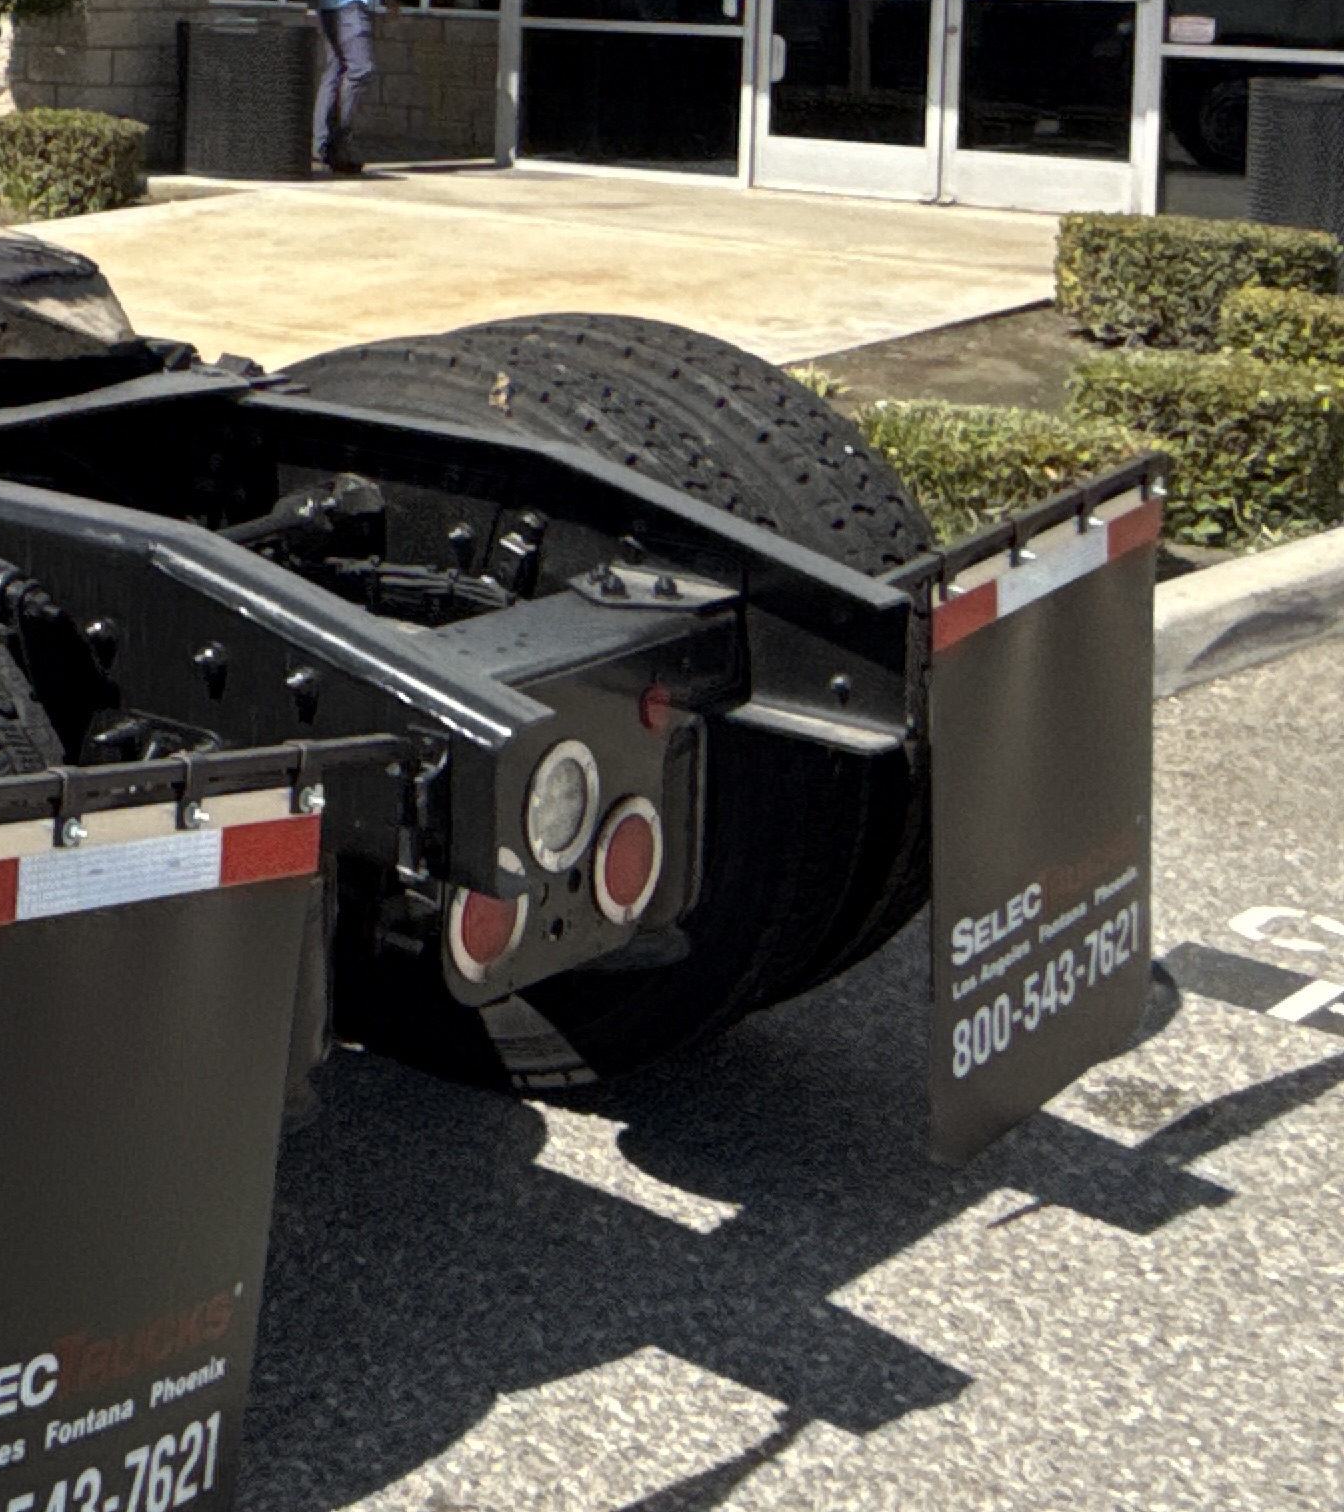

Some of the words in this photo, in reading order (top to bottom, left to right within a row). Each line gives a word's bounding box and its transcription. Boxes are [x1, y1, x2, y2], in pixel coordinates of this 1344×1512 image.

[952, 900, 1140, 1080] 800-543-7621
[43, 1397, 135, 1451] Fontana
[149, 1355, 226, 1409] Phoenix
